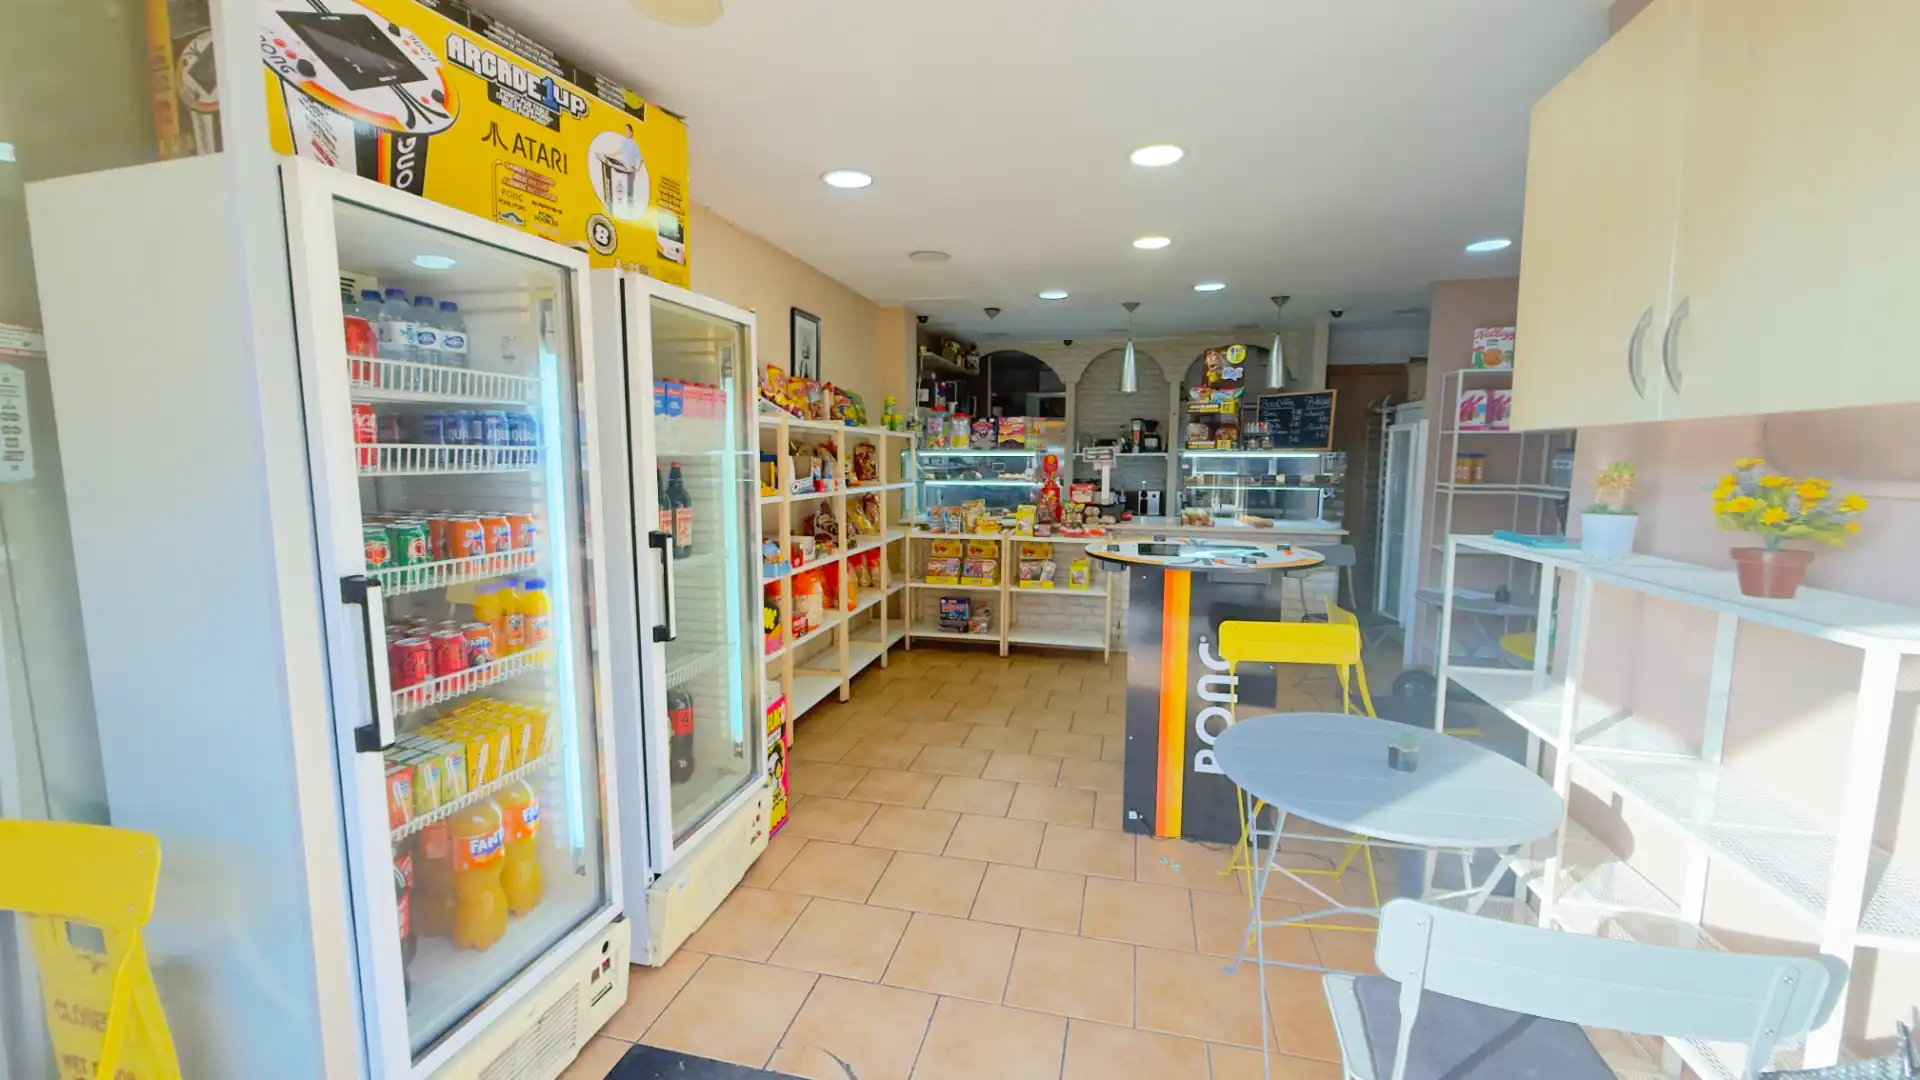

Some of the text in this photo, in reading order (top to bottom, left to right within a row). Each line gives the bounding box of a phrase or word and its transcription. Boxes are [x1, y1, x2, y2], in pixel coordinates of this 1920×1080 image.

[447, 32, 588, 119] ARCADE1UP
[512, 132, 568, 175] ATARI
[594, 223, 609, 246] 8
